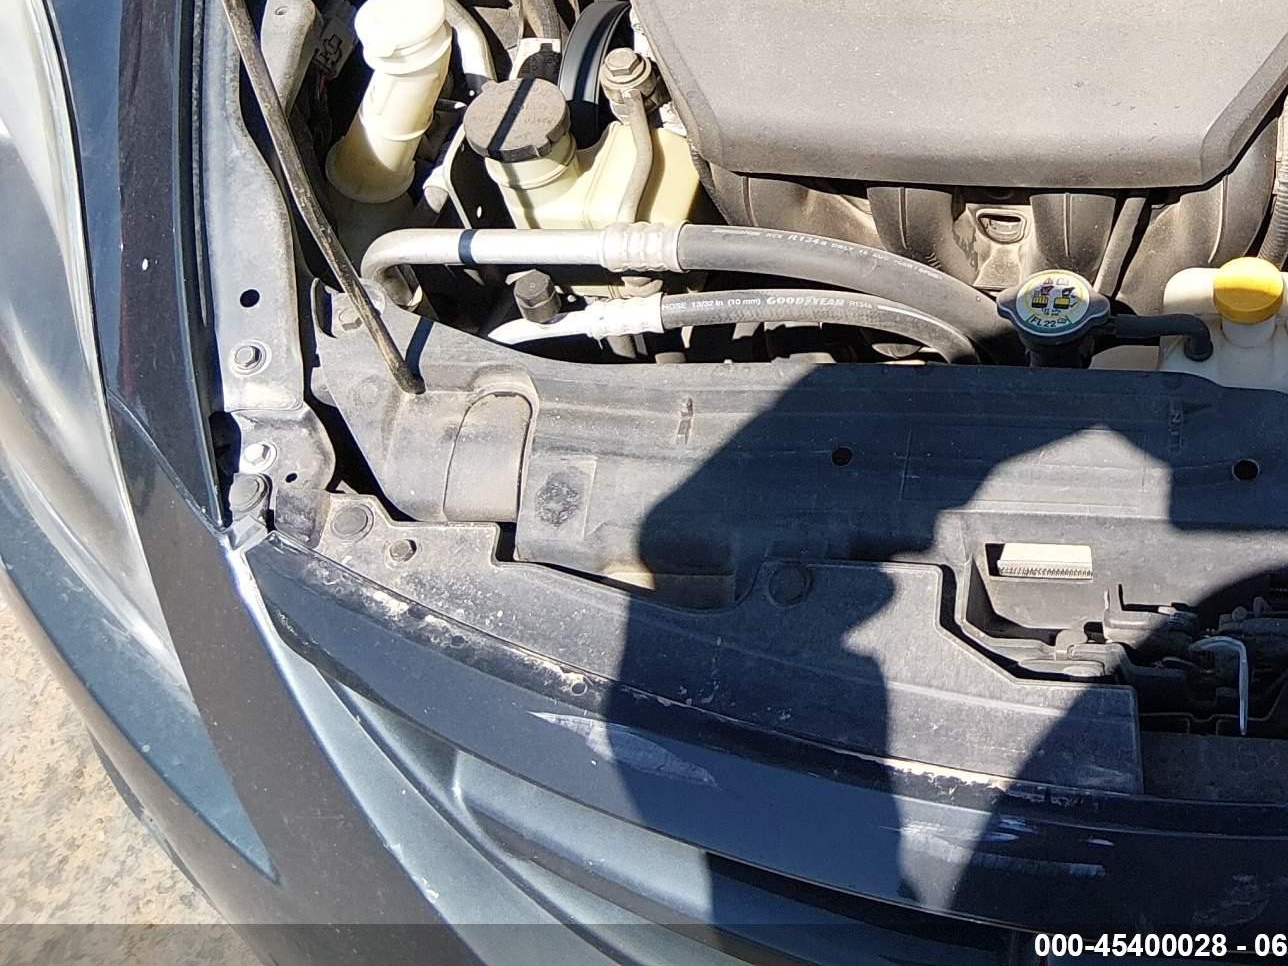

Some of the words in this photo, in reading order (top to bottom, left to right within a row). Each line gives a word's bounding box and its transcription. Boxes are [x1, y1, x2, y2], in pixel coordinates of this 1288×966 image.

[787, 234, 828, 246] R134a
[662, 301, 687, 310] HOSE
[691, 299, 714, 308] 13/32
[727, 298, 741, 308] (10
[742, 297, 761, 307] mm)
